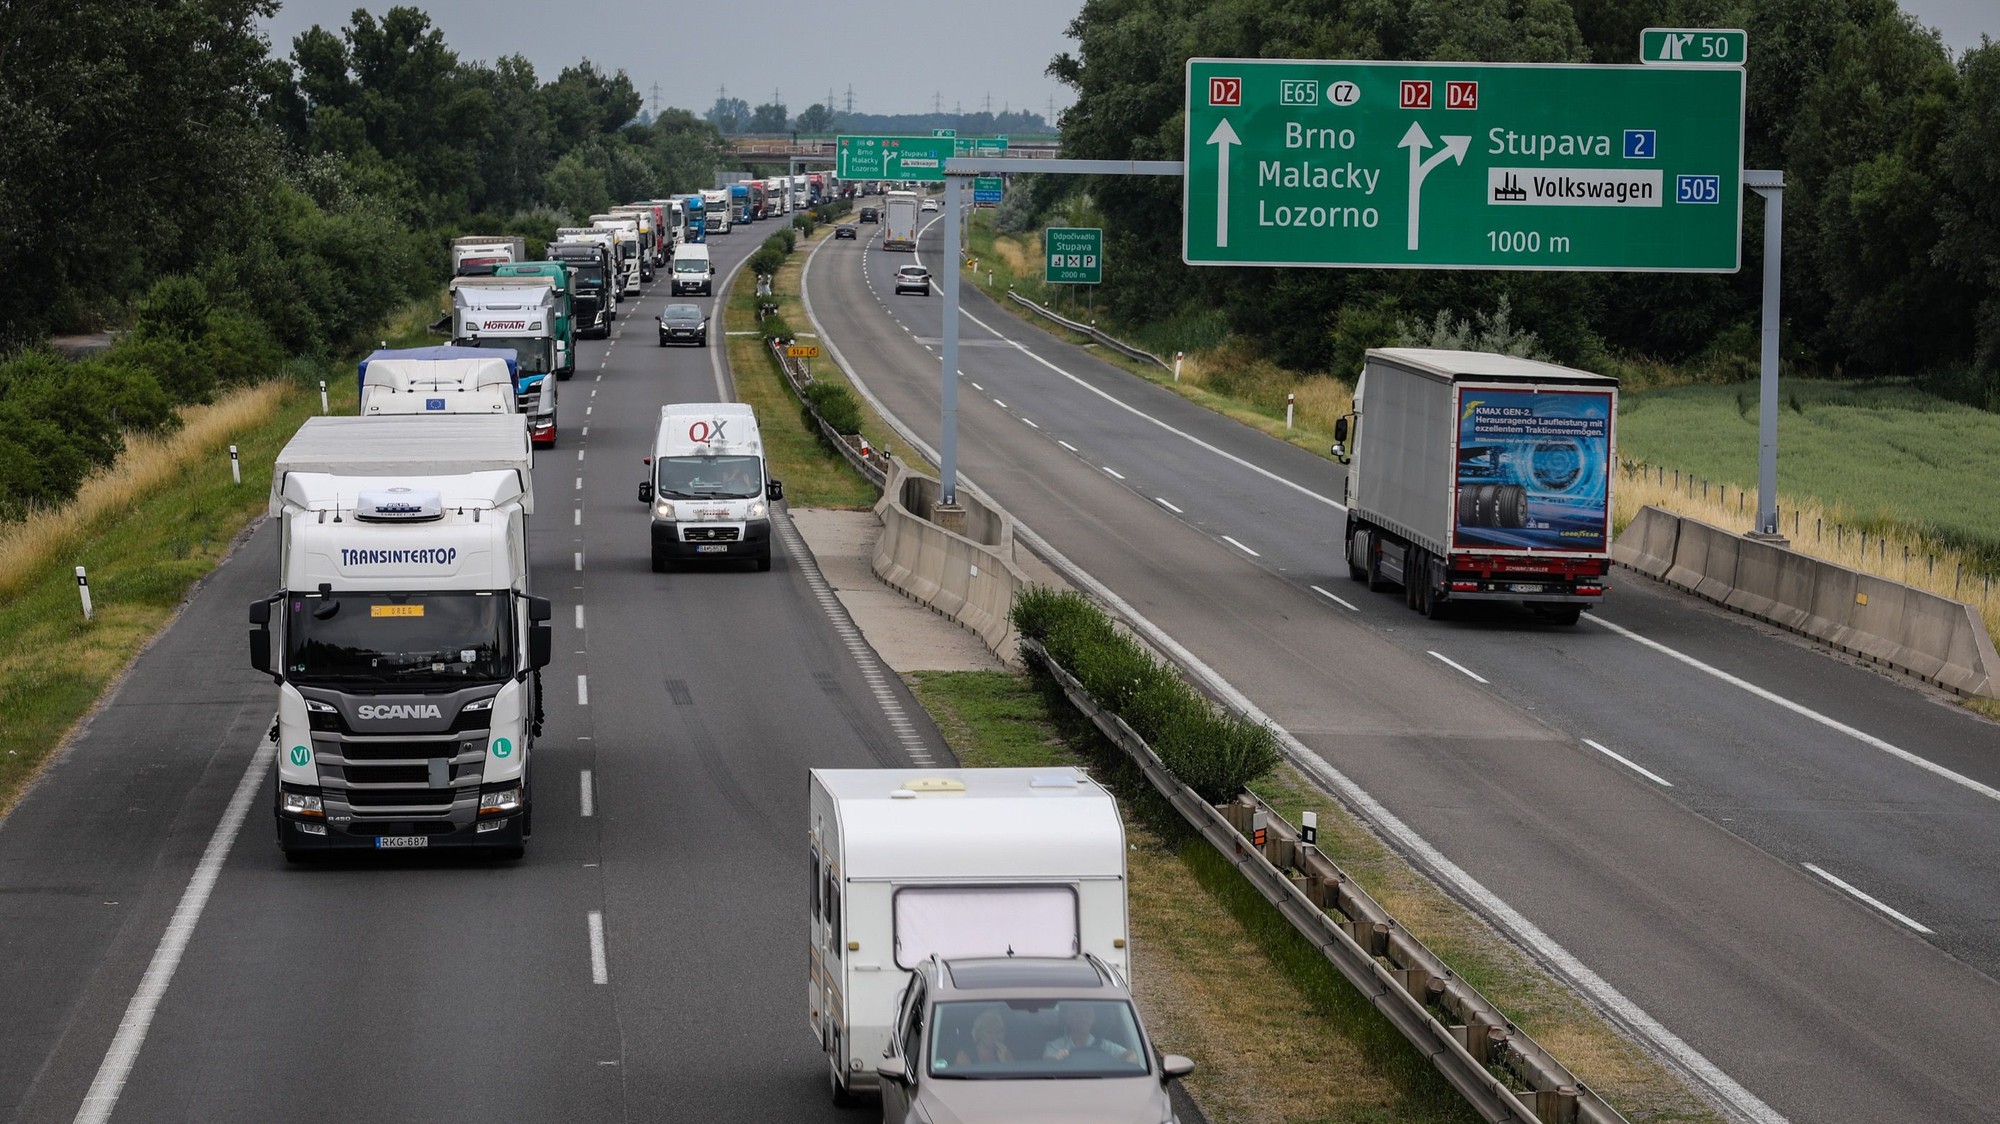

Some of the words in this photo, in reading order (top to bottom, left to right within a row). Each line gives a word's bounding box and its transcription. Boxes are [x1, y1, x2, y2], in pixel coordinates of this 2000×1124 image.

[1701, 36, 1729, 58] 50
[1213, 81, 1237, 102] D2
[1283, 83, 1316, 102] E65
[1334, 85, 1353, 102] CZ
[1403, 84, 1428, 105] D2
[1450, 85, 1475, 106] D4
[1286, 122, 1355, 149] Brno
[1488, 127, 1611, 161] Stupava
[1634, 133, 1646, 155] 2
[851, 157, 879, 165] Malacky
[857, 148, 874, 156] Brno
[900, 149, 928, 158] Stupava
[851, 165, 879, 173] Lozorno
[1259, 160, 1381, 195] Malacky
[1533, 176, 1653, 203] Volkswagen
[1681, 179, 1716, 200] 505
[1259, 200, 1379, 228] Lozorno
[1056, 241, 1092, 252] Stupava
[1487, 230, 1541, 252] 1000
[1549, 235, 1570, 252] m
[1475, 407, 1501, 416] KMAX
[1503, 408, 1532, 416] GEN-2.
[1475, 416, 1537, 426] Herausragende
[1538, 418, 1588, 428] Laufleistung
[1589, 419, 1603, 428] mit
[1475, 424, 1524, 433] exzellentem
[1525, 425, 1604, 437] Traktionsvermögen.
[689, 420, 728, 444] QX
[1560, 530, 1600, 538] GOODYEAR
[341, 547, 457, 567] TRANSINTERTOP
[358, 704, 442, 720] SCANIA
[293, 749, 308, 763] VI
[498, 741, 507, 755] L
[382, 837, 426, 847] RKG-687
